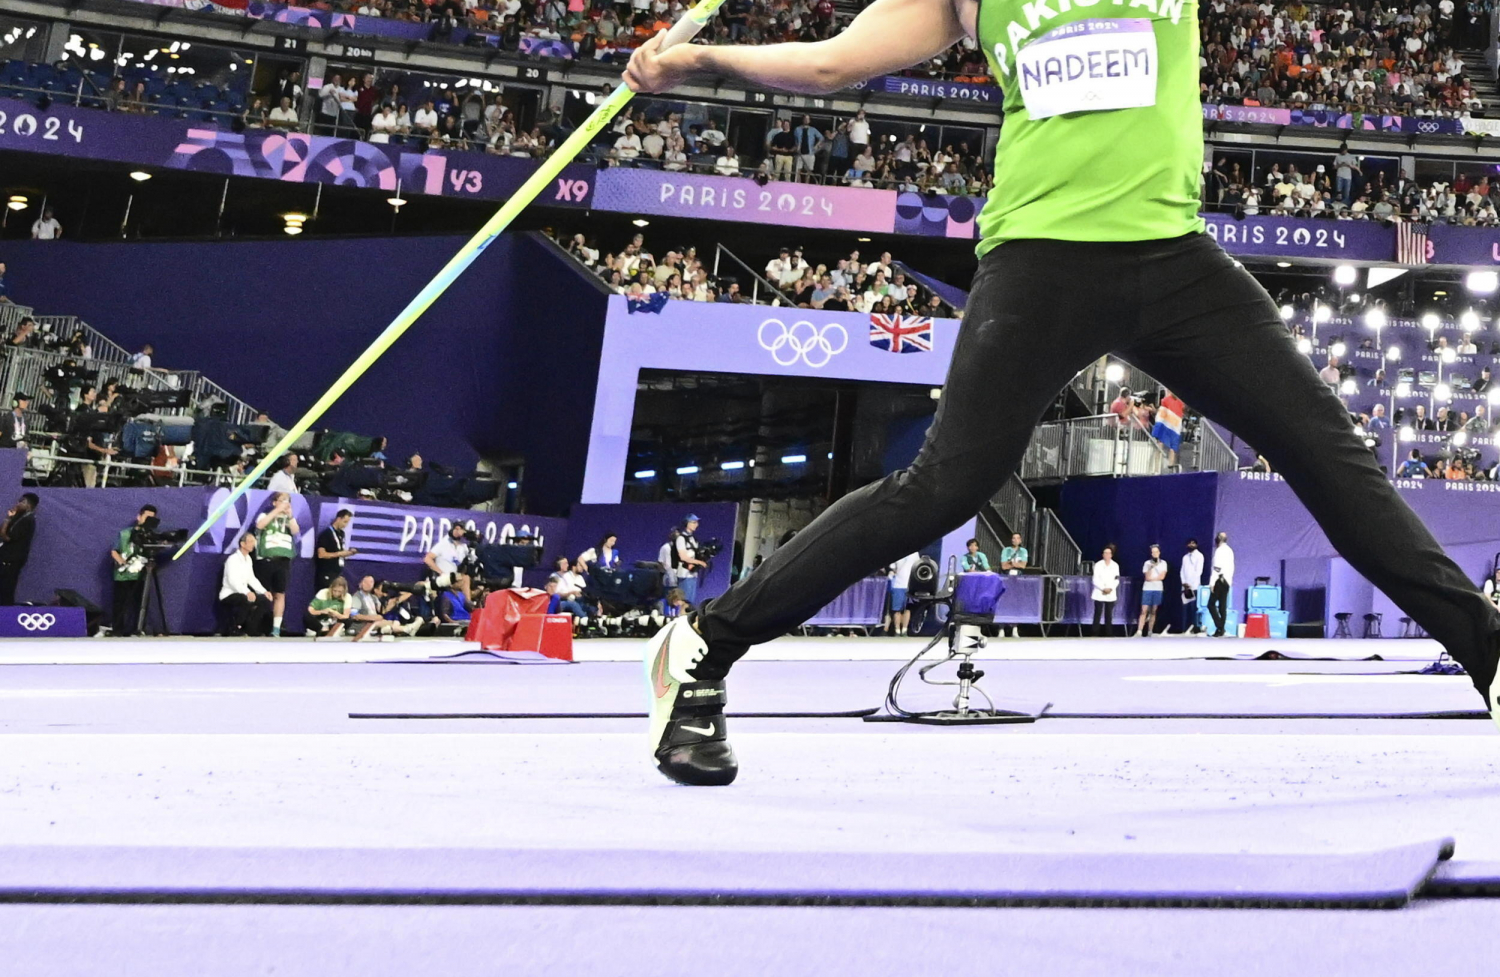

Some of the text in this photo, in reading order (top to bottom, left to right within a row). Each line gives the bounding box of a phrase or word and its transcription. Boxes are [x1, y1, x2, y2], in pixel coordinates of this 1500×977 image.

[1088, 21, 1119, 32] 2024
[284, 38, 297, 49] 21
[526, 68, 539, 78] 20
[1022, 48, 1150, 90] NADEEM
[755, 93, 765, 102] 19
[901, 82, 989, 102] PARIS 2024
[1238, 111, 1276, 122] 2024
[556, 179, 588, 203] X9
[660, 183, 833, 217] PARIS 2024
[1206, 224, 1345, 248] ARIS 2024
[1241, 472, 1270, 482] PARIS
[1397, 480, 1422, 489] 2024
[1446, 482, 1500, 492] PARIS 2024
